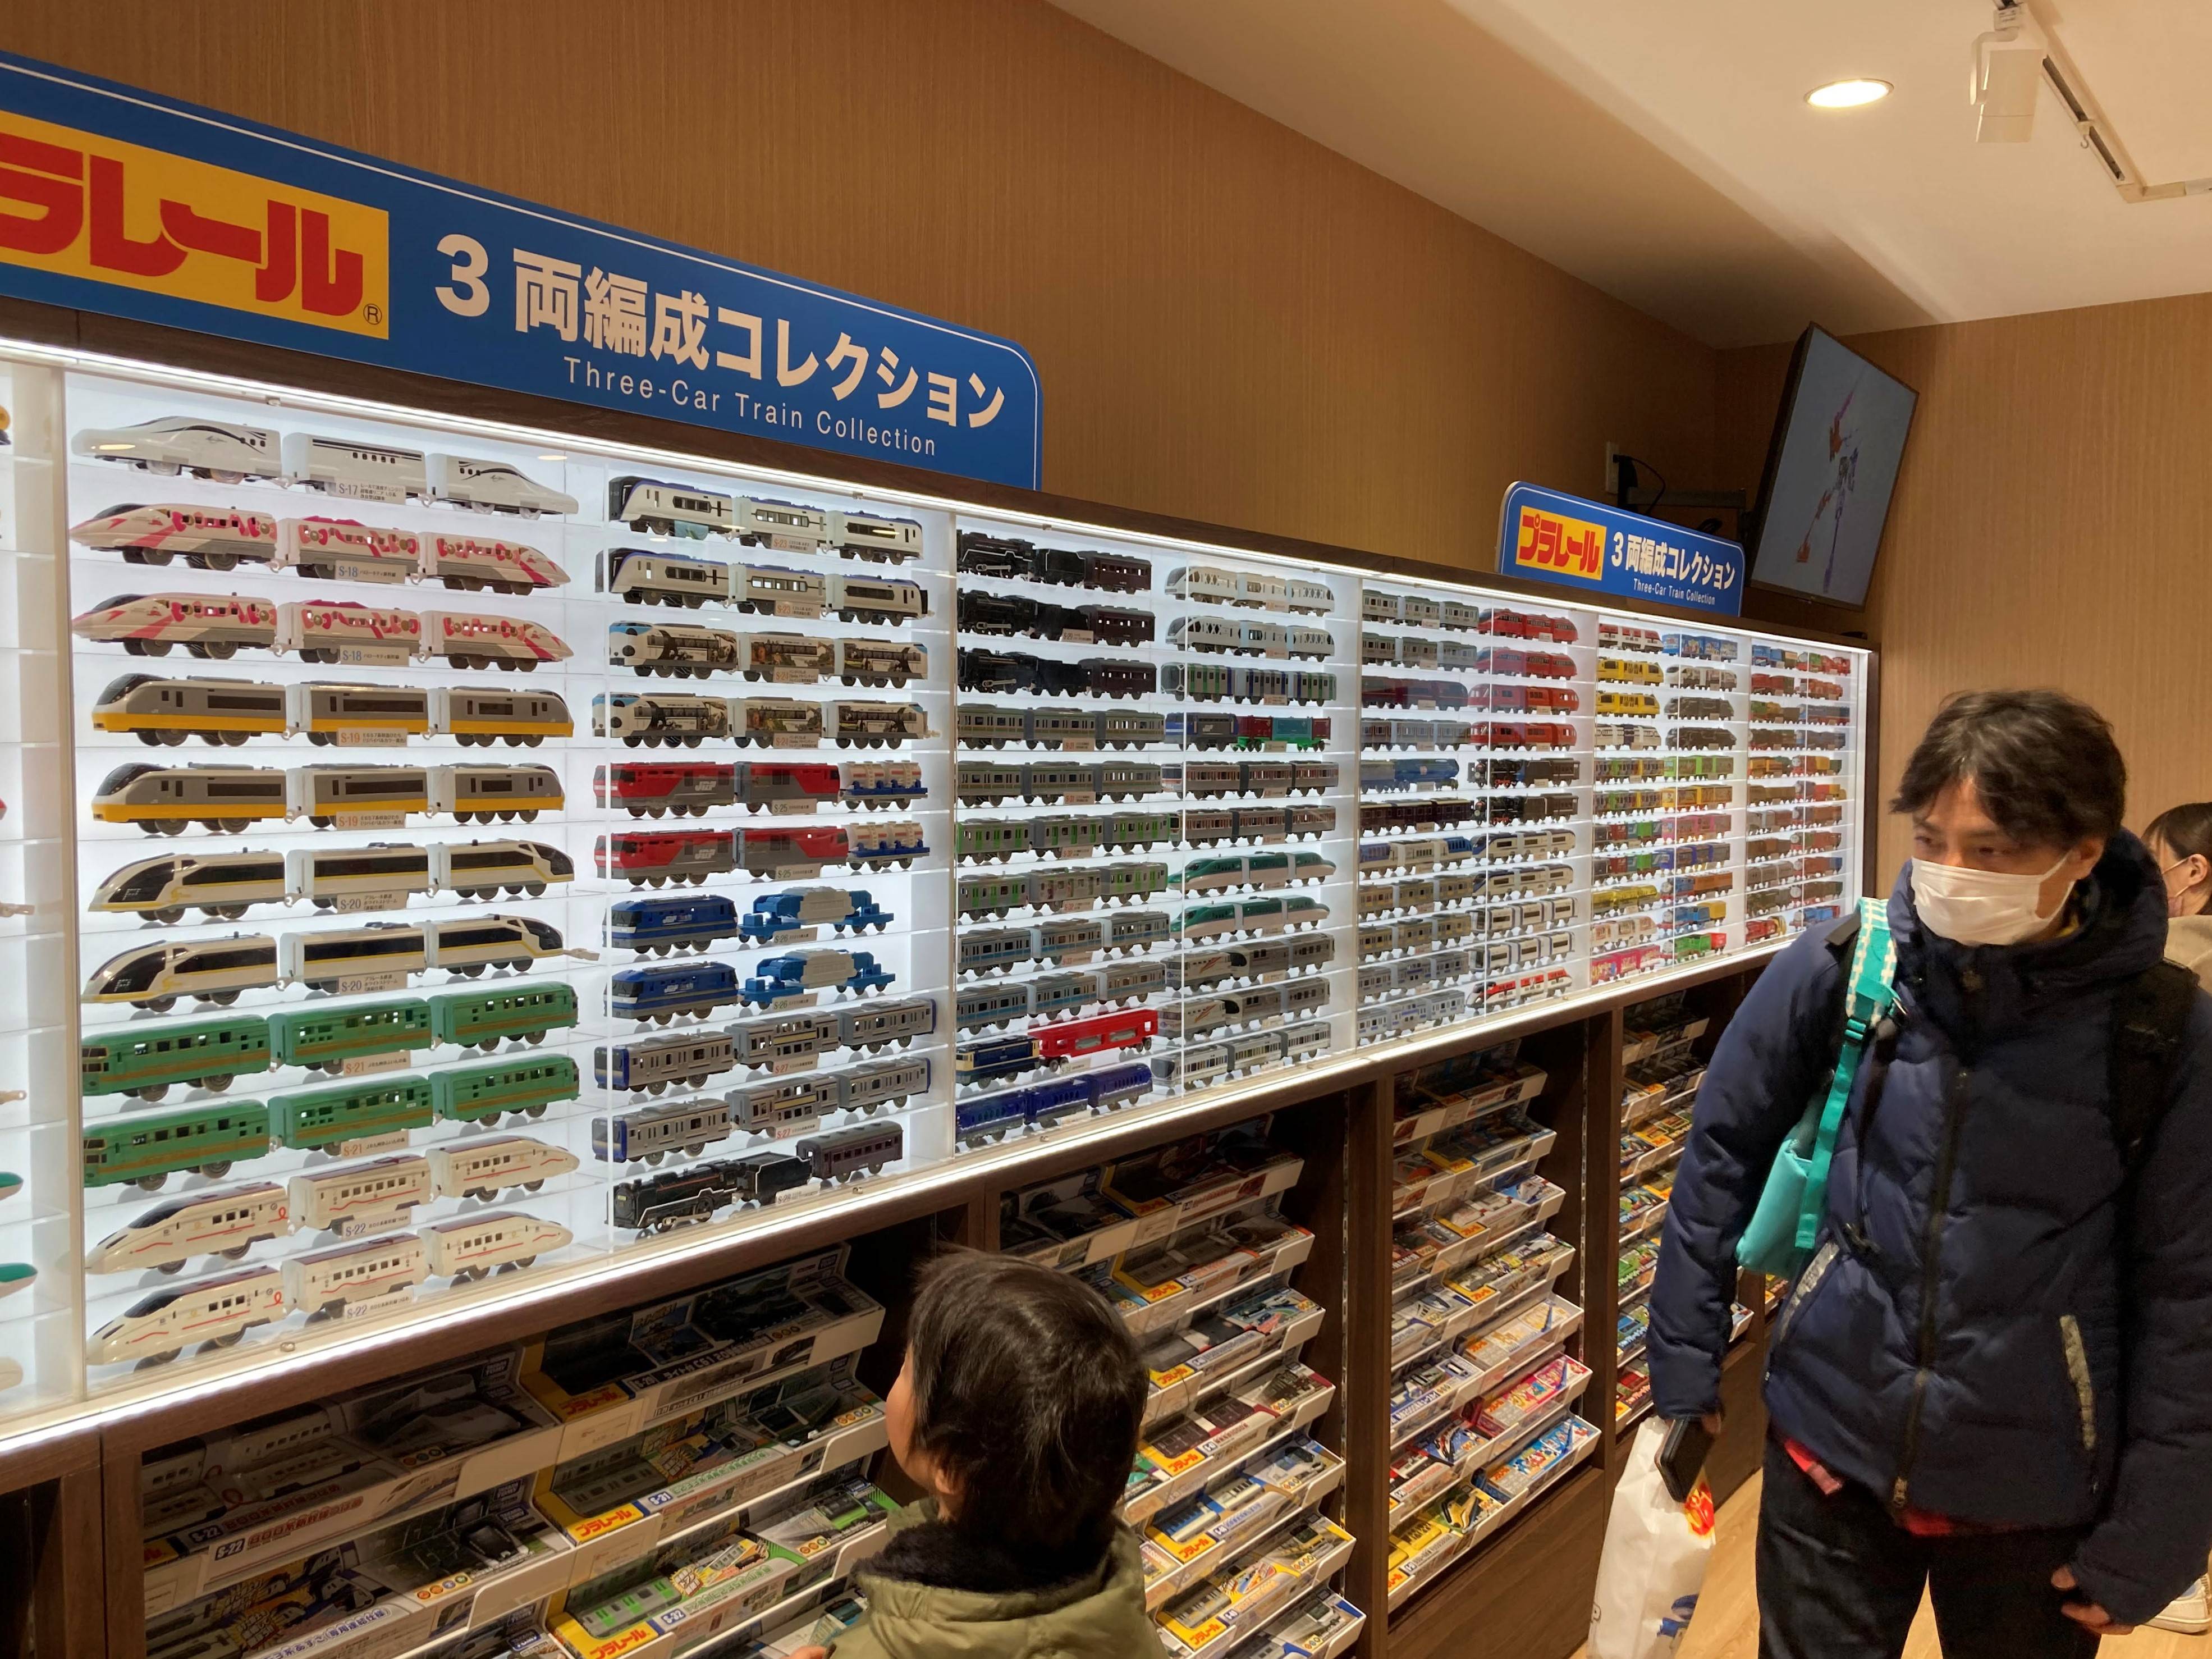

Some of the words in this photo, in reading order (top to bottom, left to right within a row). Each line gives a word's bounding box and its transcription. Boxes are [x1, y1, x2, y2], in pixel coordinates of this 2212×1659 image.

[563, 357, 720, 413] Three-Car
[735, 392, 802, 429] Train
[817, 410, 935, 456] Collection
[339, 483, 358, 496] S-17
[1519, 513, 1600, 573] プラレール
[339, 566, 358, 577] S-18
[1633, 578, 1666, 597] Three-Car
[1669, 585, 1684, 599] Train
[1686, 588, 1715, 605] Collection
[343, 651, 361, 661] S-18
[341, 732, 360, 743] S-19
[774, 803, 787, 812] S-25
[339, 816, 358, 827] S-19
[778, 870, 791, 879] S-25
[341, 899, 361, 910] S-20
[775, 934, 788, 943] S-26
[342, 981, 361, 991] S-20
[774, 1000, 787, 1009] S-26
[346, 1062, 364, 1074] S-21
[775, 1064, 788, 1073] S-27
[777, 1128, 790, 1139] S-27
[344, 1144, 362, 1157] S-21
[346, 1223, 366, 1236] S-22
[347, 1305, 367, 1319] S-22
[576, 1509, 632, 1537] プラレール
[217, 1541, 242, 1559] S-22
